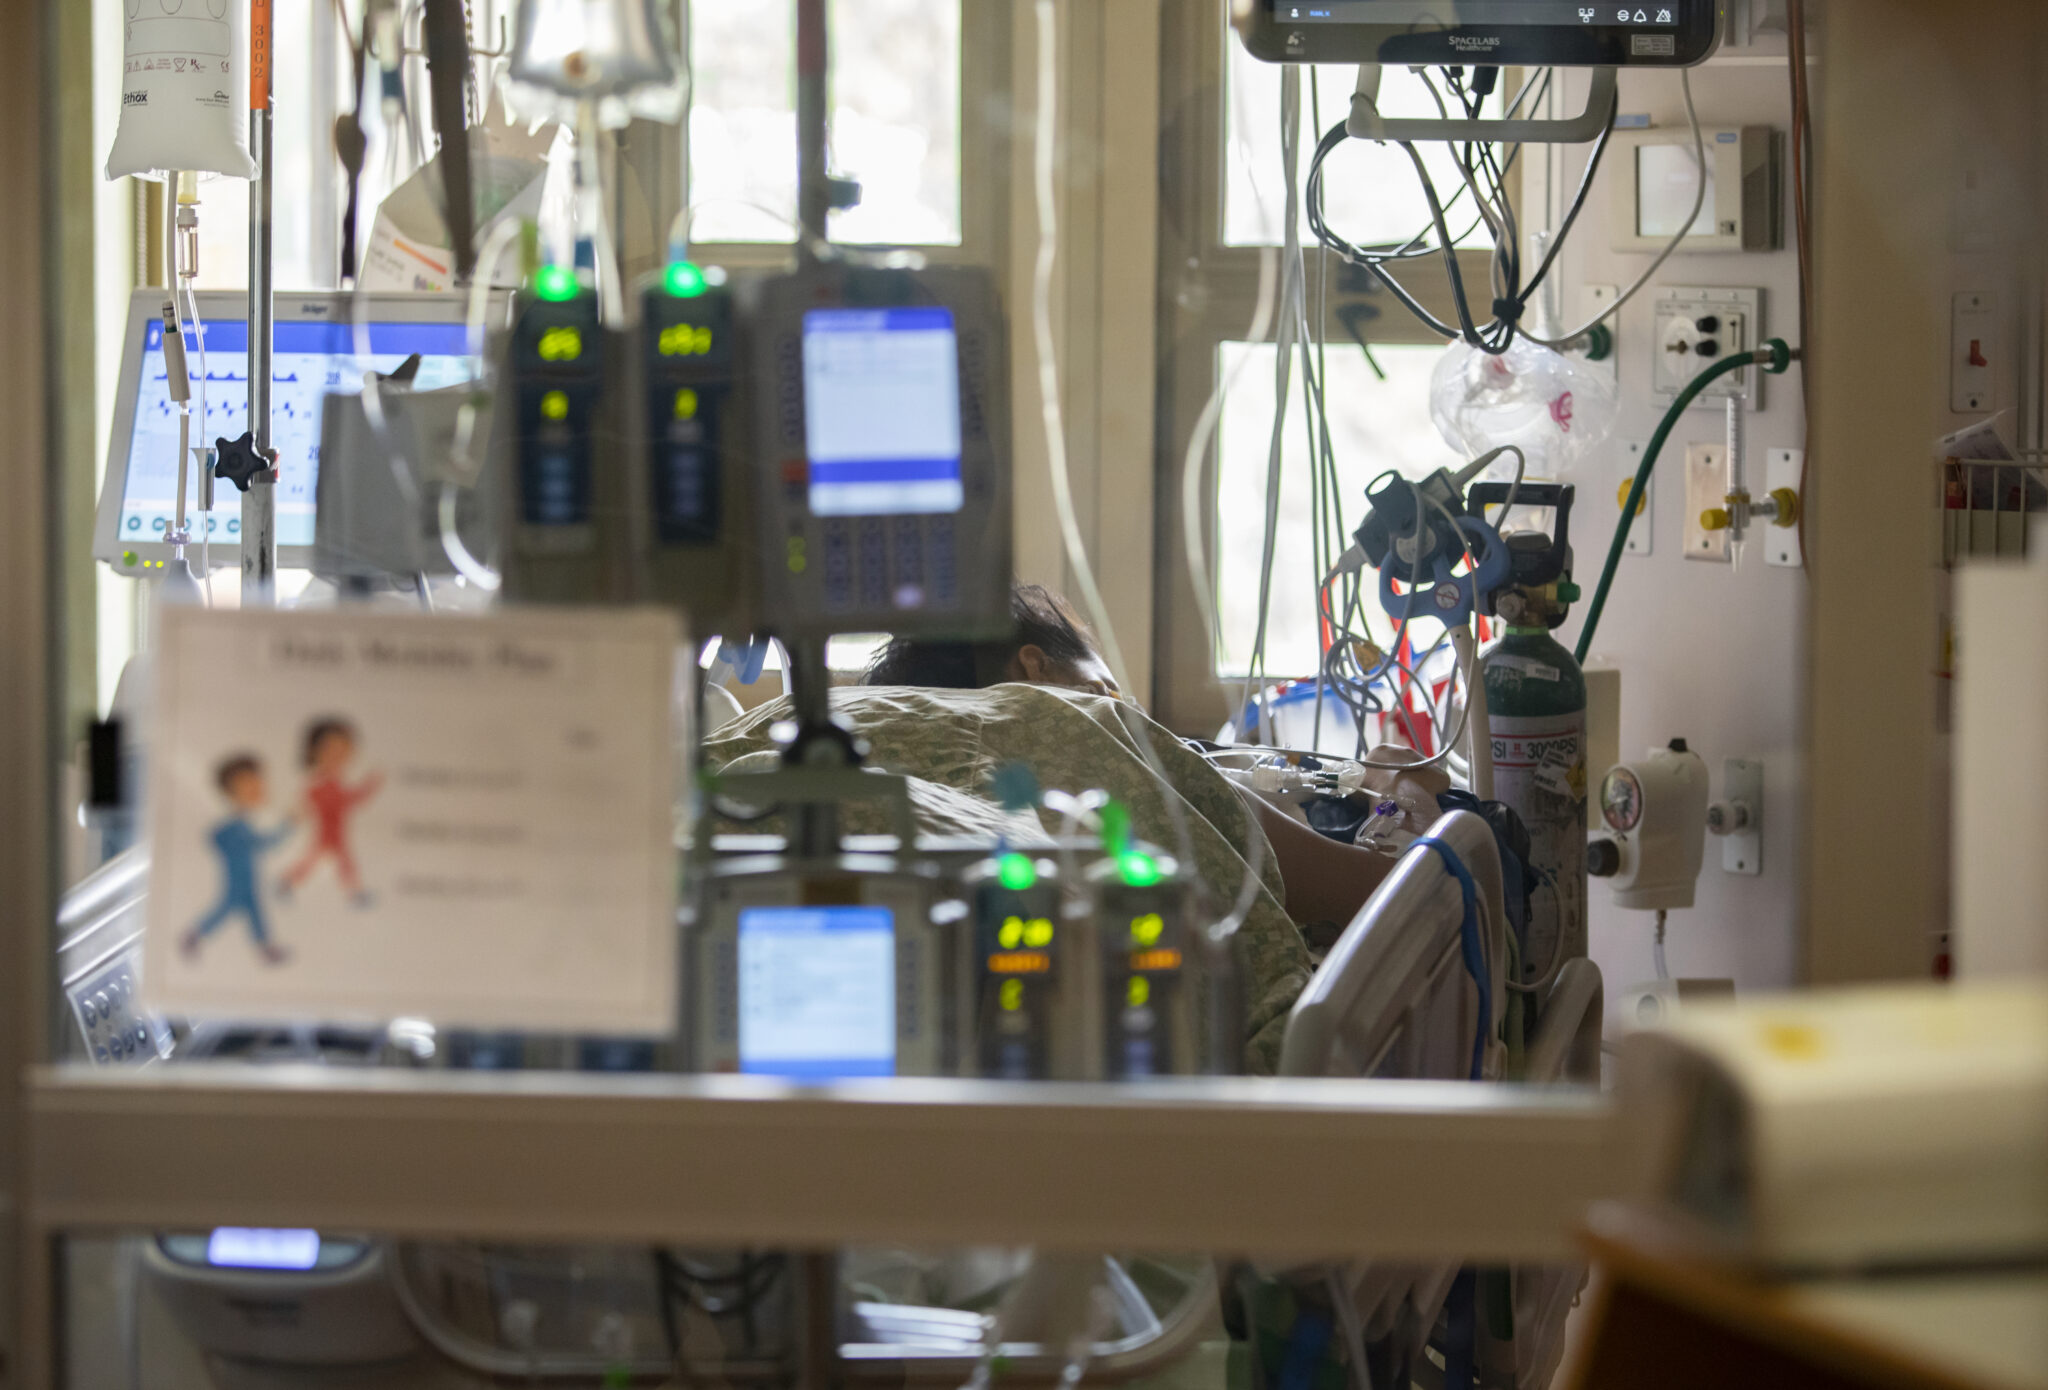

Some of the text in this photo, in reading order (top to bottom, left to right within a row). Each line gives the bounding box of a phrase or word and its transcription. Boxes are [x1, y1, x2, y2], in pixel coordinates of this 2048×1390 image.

[1448, 35, 1500, 46] SPACELABS
[254, 24, 264, 78] 3002
[123, 92, 148, 105] Ethox
[1491, 742, 1507, 759] SI
